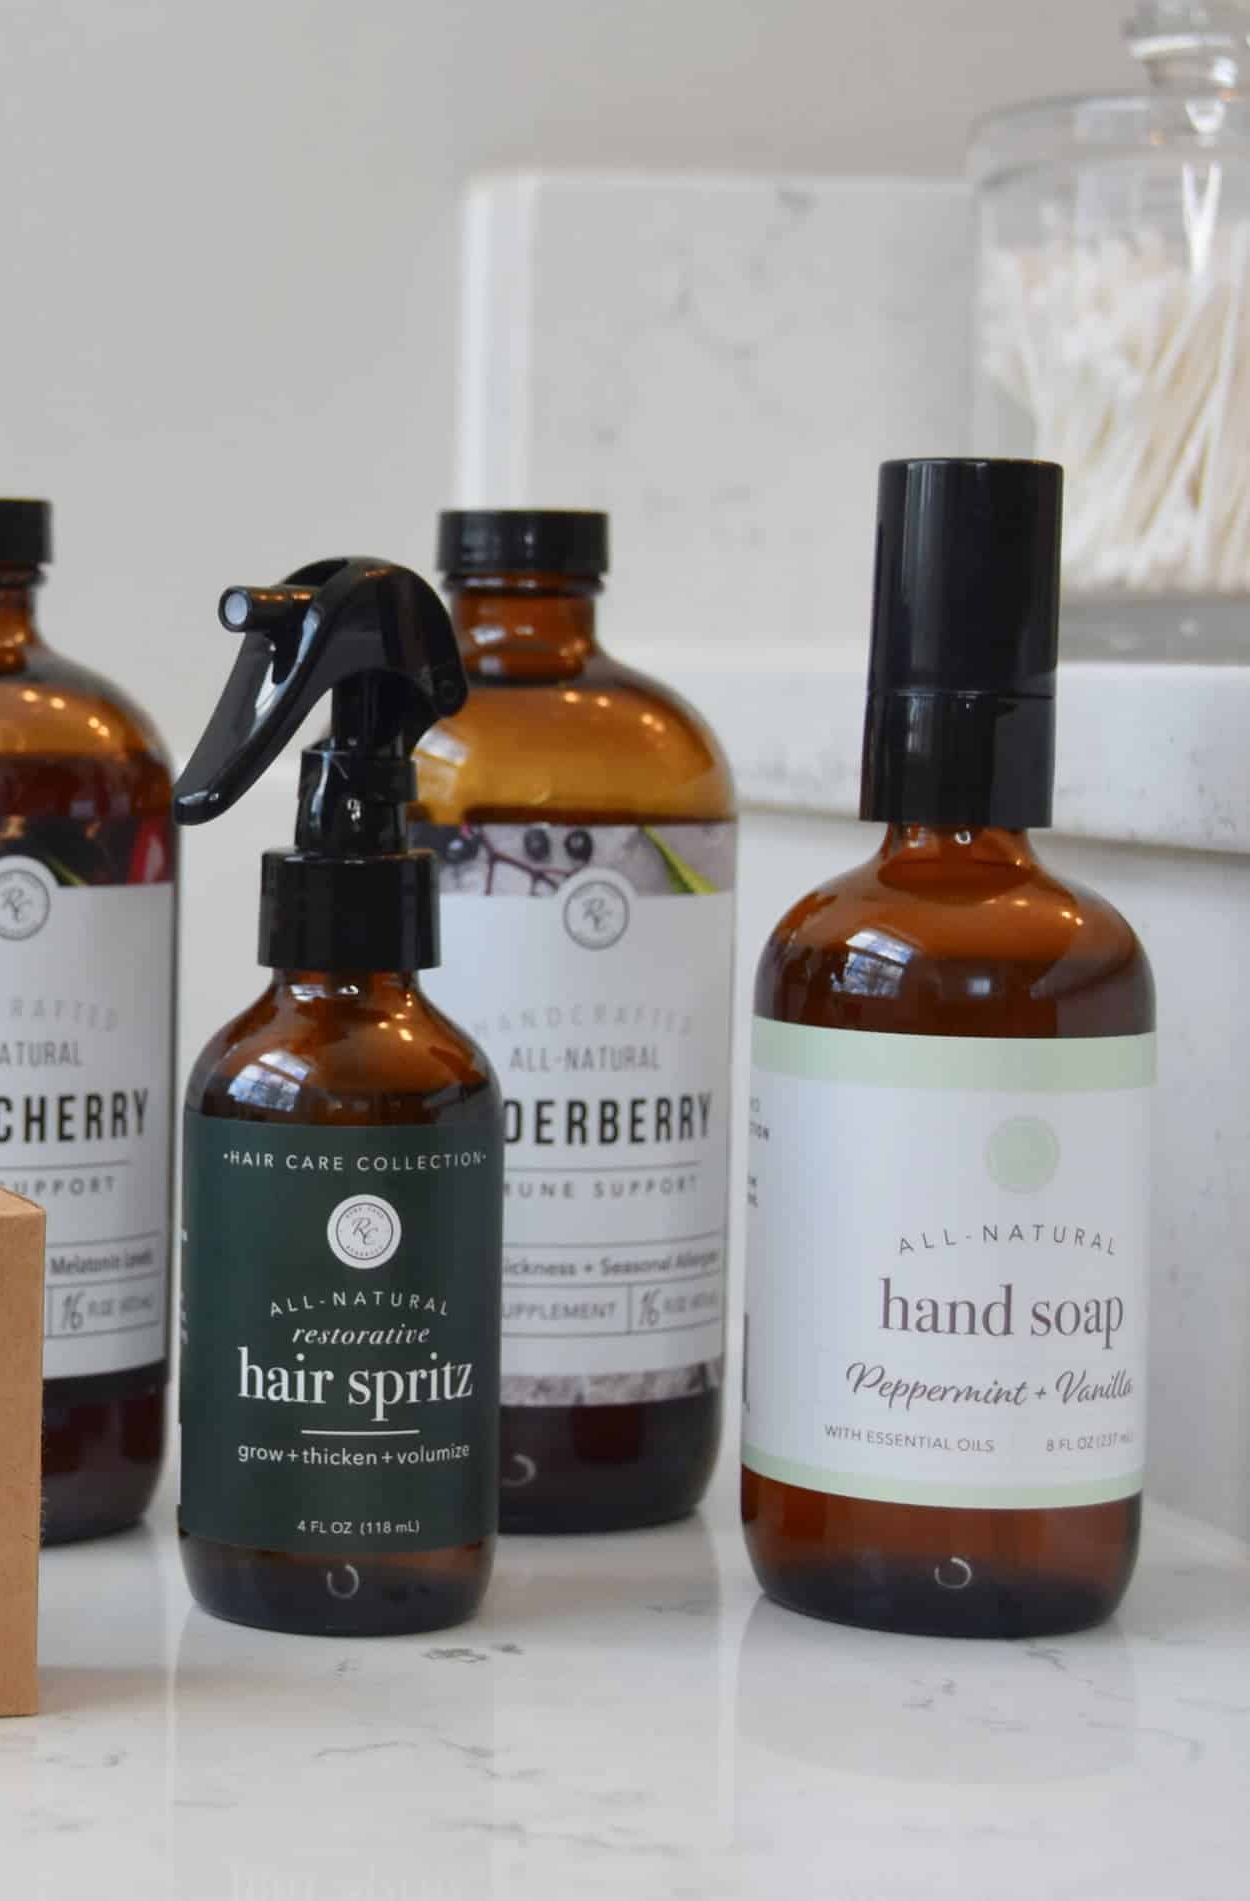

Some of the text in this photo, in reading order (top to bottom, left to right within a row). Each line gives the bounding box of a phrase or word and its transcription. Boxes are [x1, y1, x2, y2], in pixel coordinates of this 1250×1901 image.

[509, 1044, 661, 1071] ALL-NATURAL
[503, 1092, 712, 1145] DERBERRY
[286, 1153, 344, 1171] CARE
[593, 1174, 698, 1198] SUPPORT
[898, 1224, 1117, 1256] ALL-NATURAL
[503, 1255, 576, 1277] ickness
[270, 1290, 449, 1317] ALL-NATURAL
[502, 1301, 616, 1321] UPPLEMENT
[878, 1277, 1125, 1350] hand soap
[291, 1326, 431, 1346] restorative
[238, 1347, 474, 1422] hair spritz
[846, 1362, 1027, 1411] Peppermint
[1054, 1369, 1133, 1404] Vanilla
[824, 1424, 996, 1452] WITH ESSENTIAL OILS
[1046, 1438, 1054, 1452] 8
[1059, 1438, 1075, 1451] FL
[1077, 1435, 1094, 1450] OZ
[297, 1519, 421, 1535] 4 FL OZ (118 mL)
